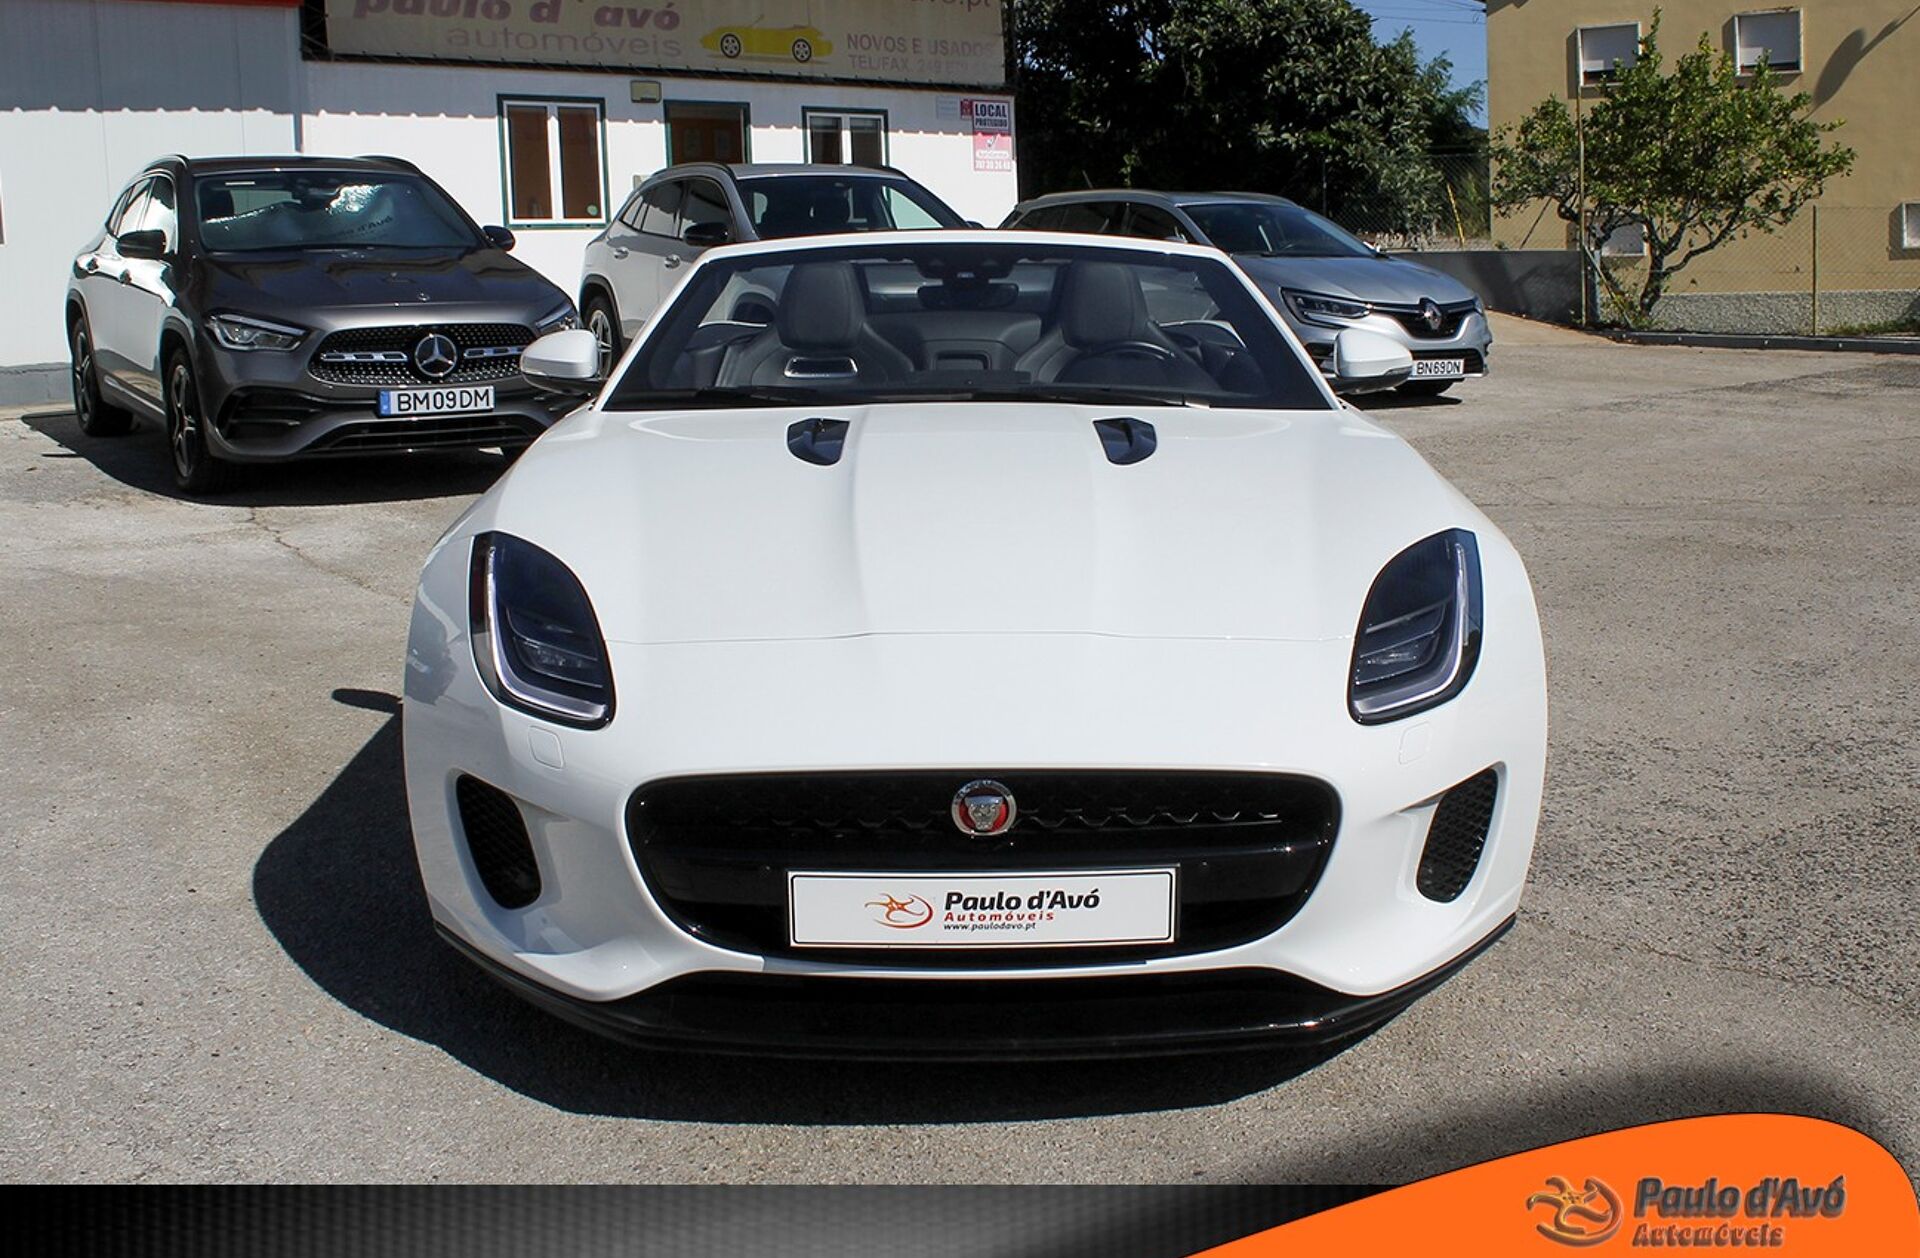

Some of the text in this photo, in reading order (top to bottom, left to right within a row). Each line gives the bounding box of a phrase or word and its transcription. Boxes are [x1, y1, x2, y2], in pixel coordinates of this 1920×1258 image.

[447, 27, 682, 57] automóveis
[847, 33, 907, 53] NOVOS
[912, 38, 922, 54] E
[975, 103, 1007, 118] LOCAL
[1416, 361, 1461, 375] BN69DN
[397, 388, 490, 412] BM09DM
[944, 888, 1100, 911] Paulo d'Avó
[944, 911, 1055, 922] Automóveis
[943, 922, 1037, 931] www.paulodavo.pt
